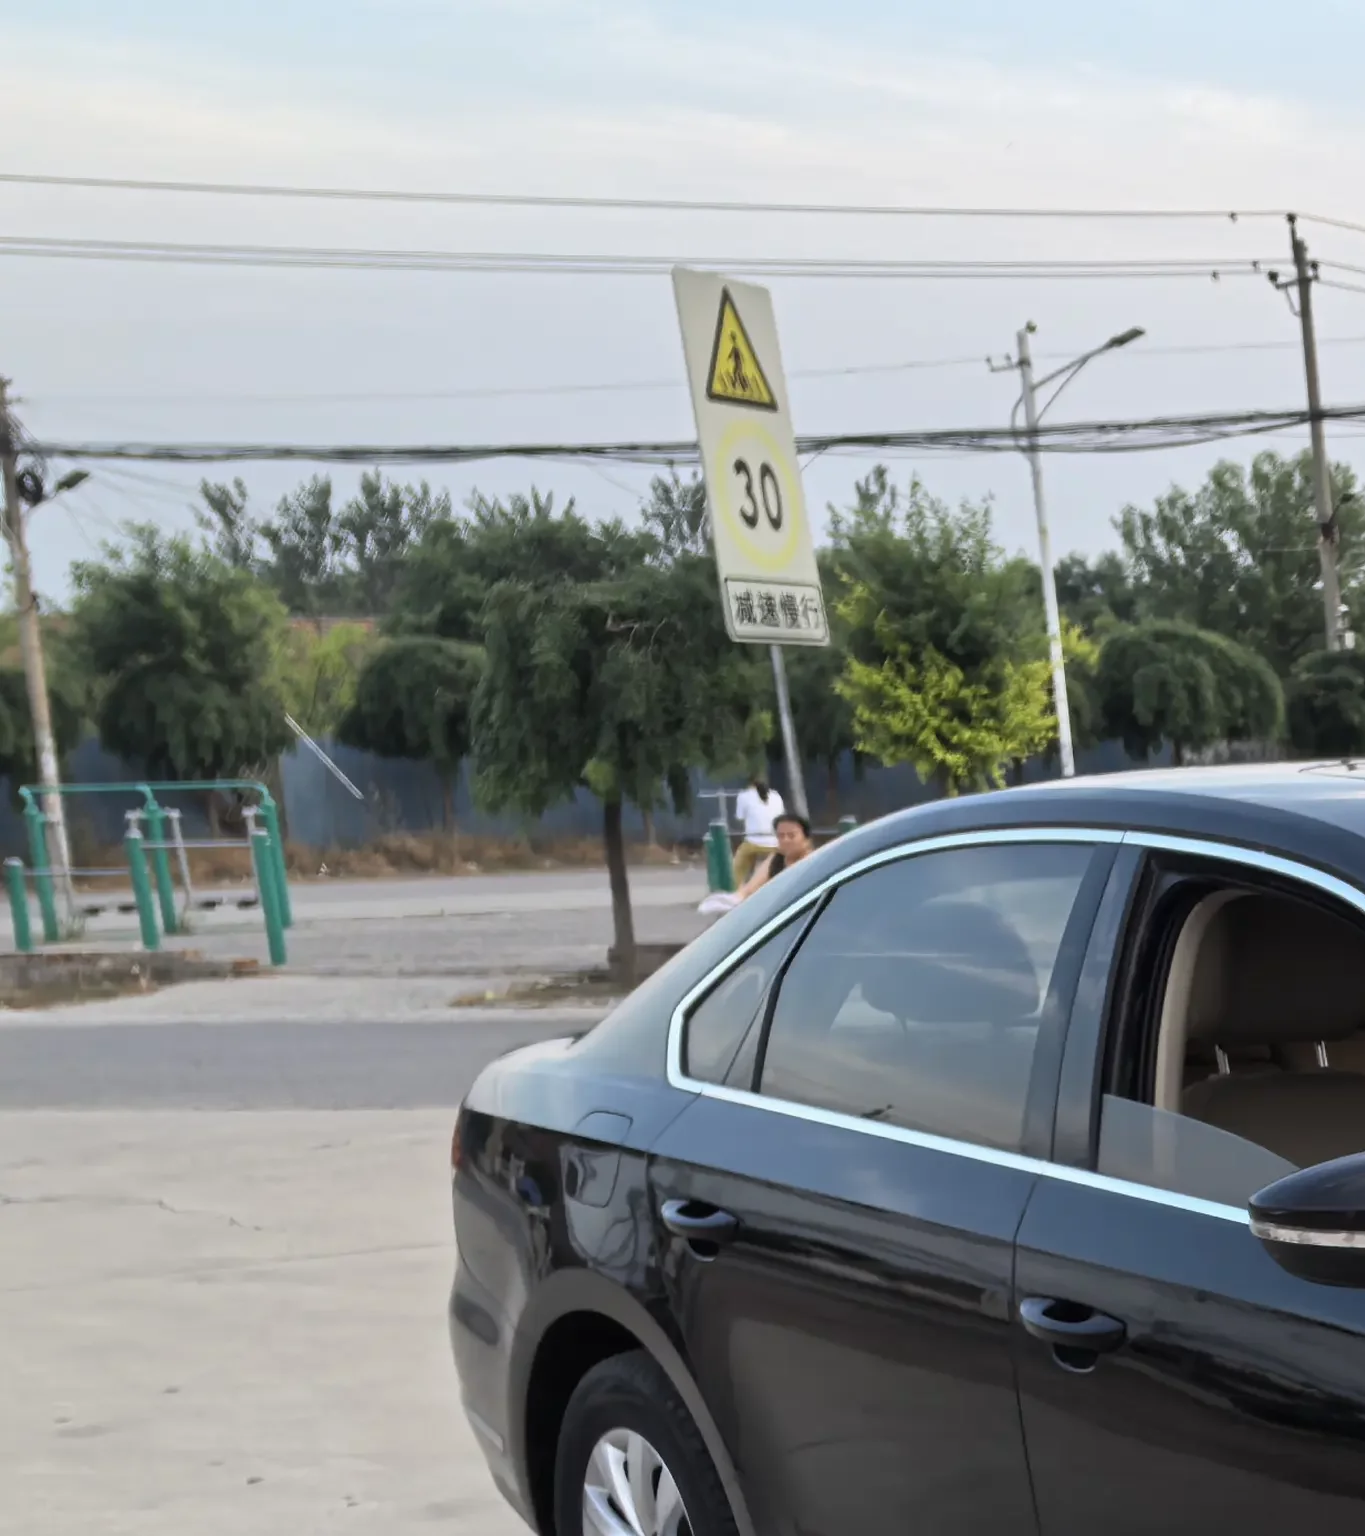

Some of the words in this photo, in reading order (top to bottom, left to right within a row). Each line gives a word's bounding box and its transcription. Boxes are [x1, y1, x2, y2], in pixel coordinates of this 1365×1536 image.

[734, 457, 783, 532] 30
[734, 590, 821, 631] 减速慢行
